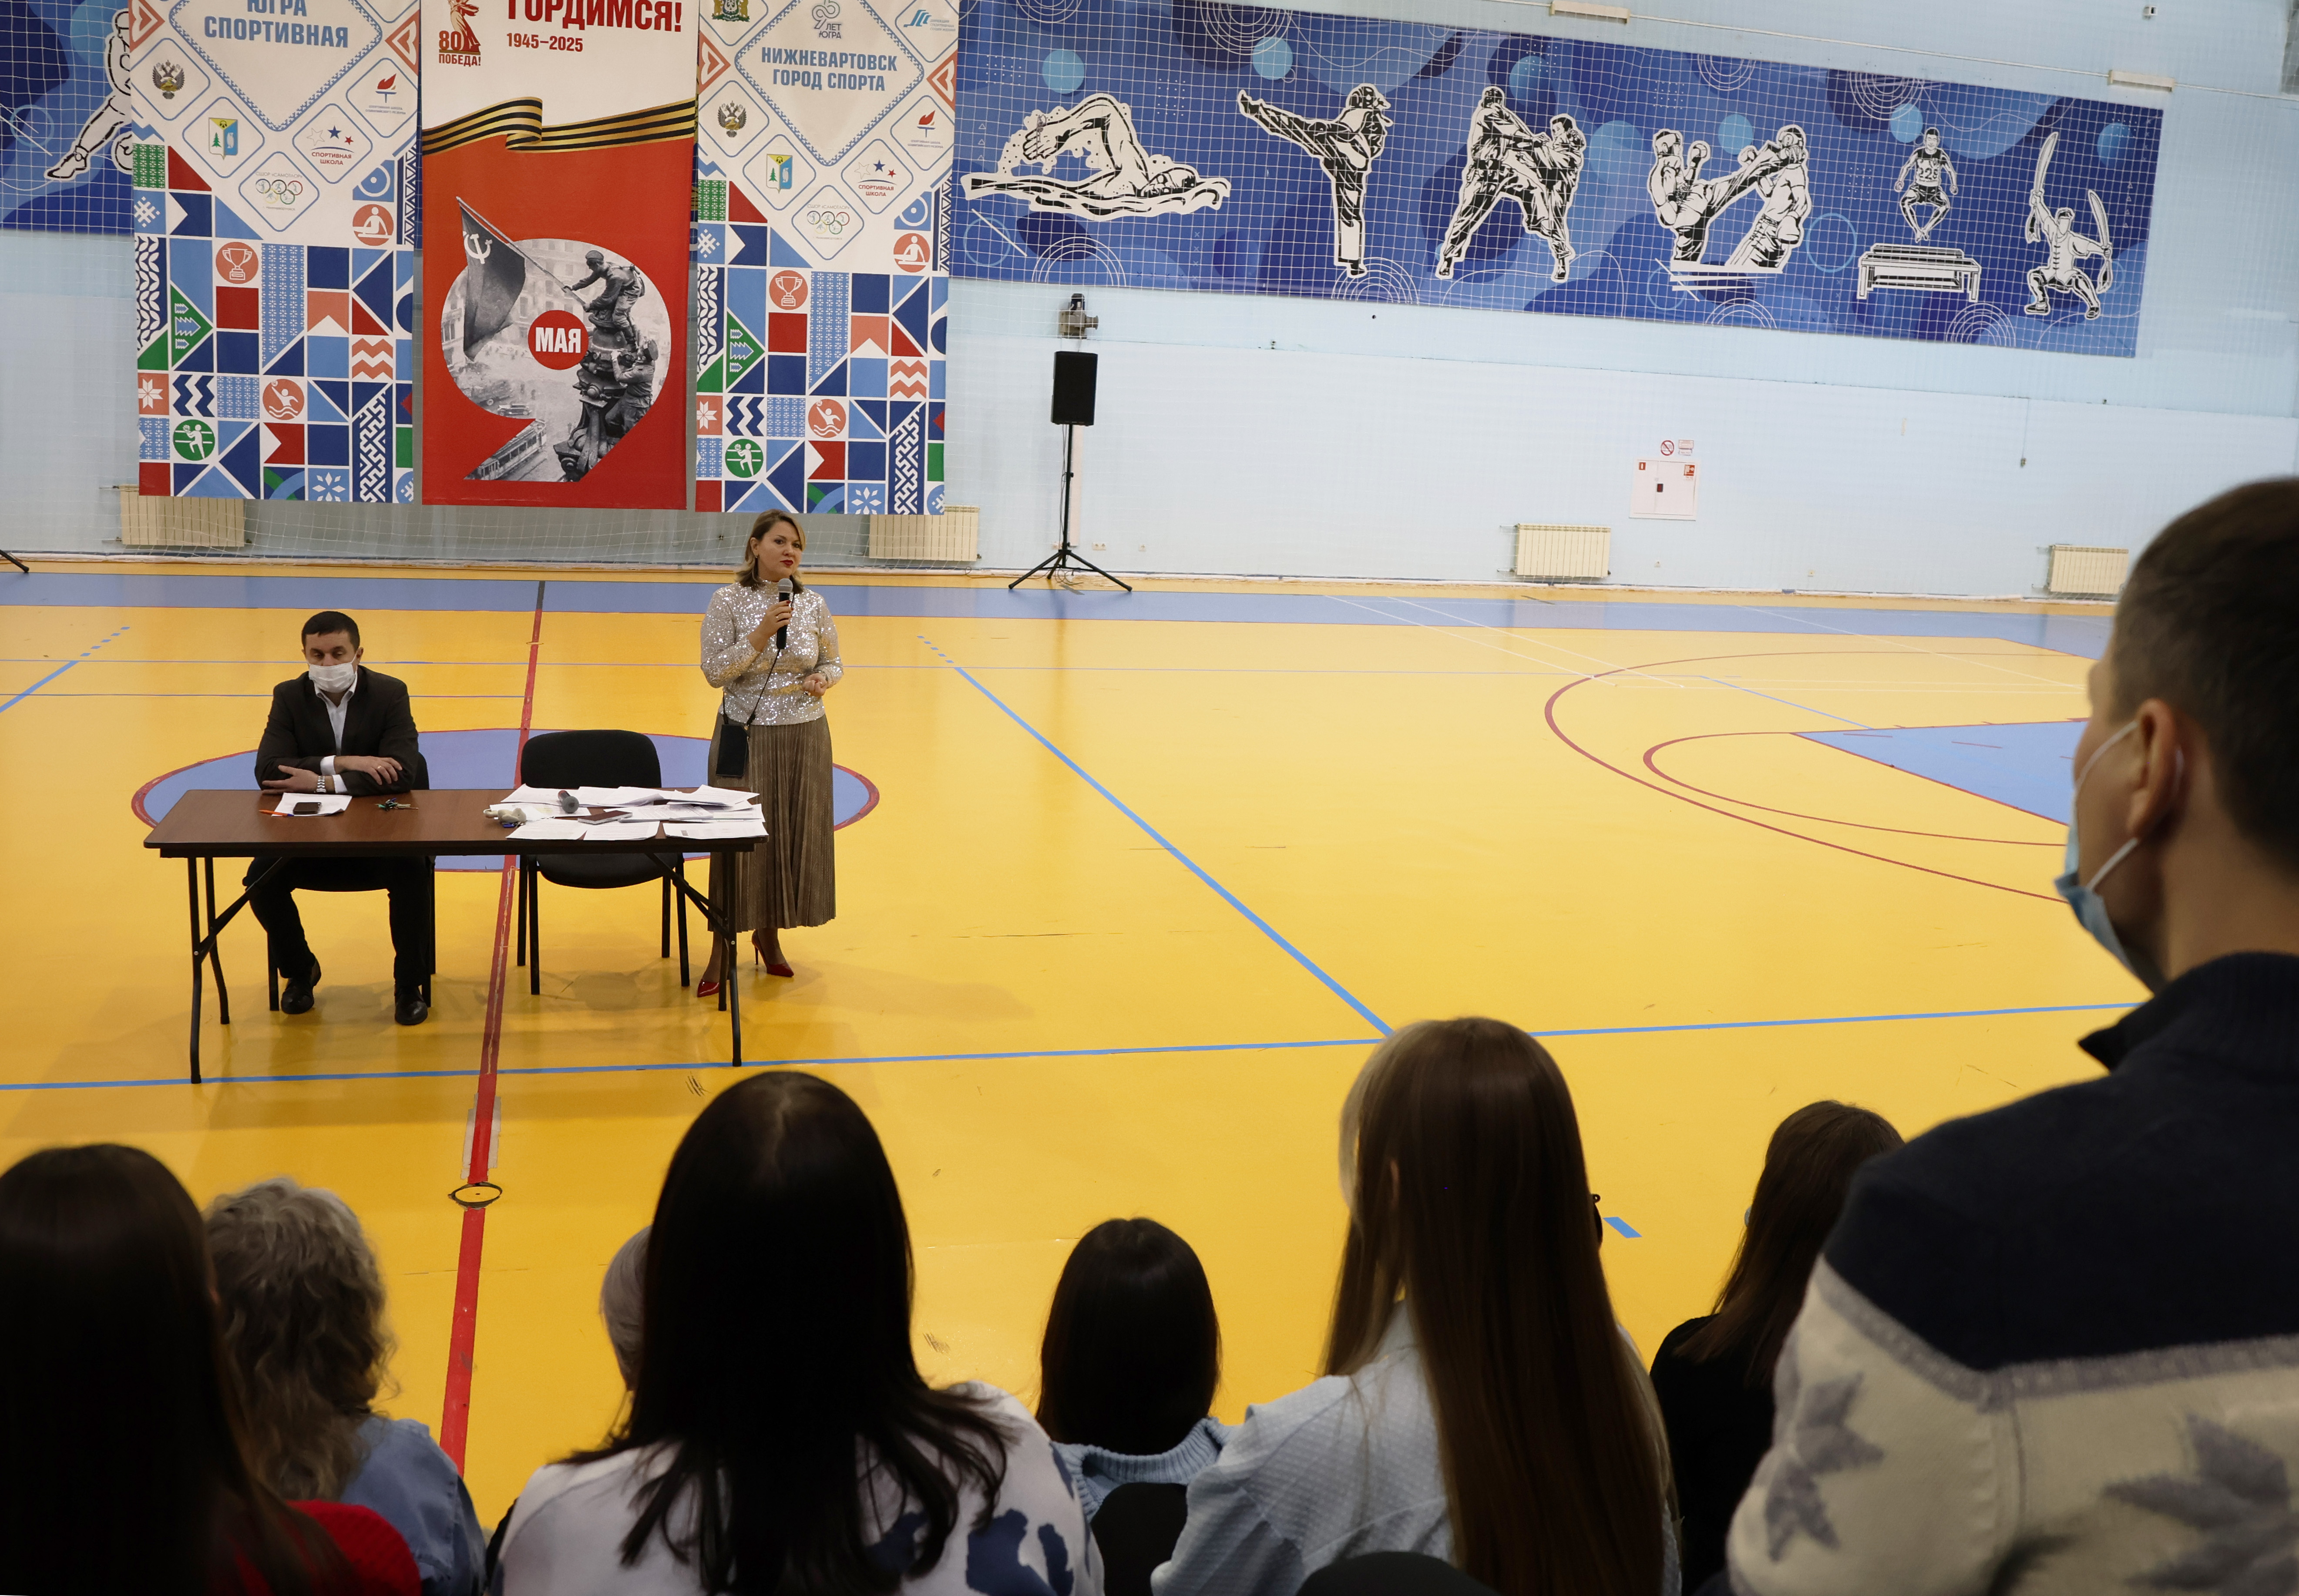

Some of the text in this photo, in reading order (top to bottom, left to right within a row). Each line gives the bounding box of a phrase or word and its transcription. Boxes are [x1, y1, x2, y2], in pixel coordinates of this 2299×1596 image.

[204, 16, 348, 48] СПОРТИВНАЯ
[439, 30, 462, 50] 80
[819, 30, 841, 39] ЮГРА
[439, 54, 481, 67] ПОБЕДА!
[761, 47, 897, 71] НИЖНЕВАРТОВСК
[773, 69, 885, 91] ГОРОД СПОРТА
[535, 327, 581, 353] МАЯ
